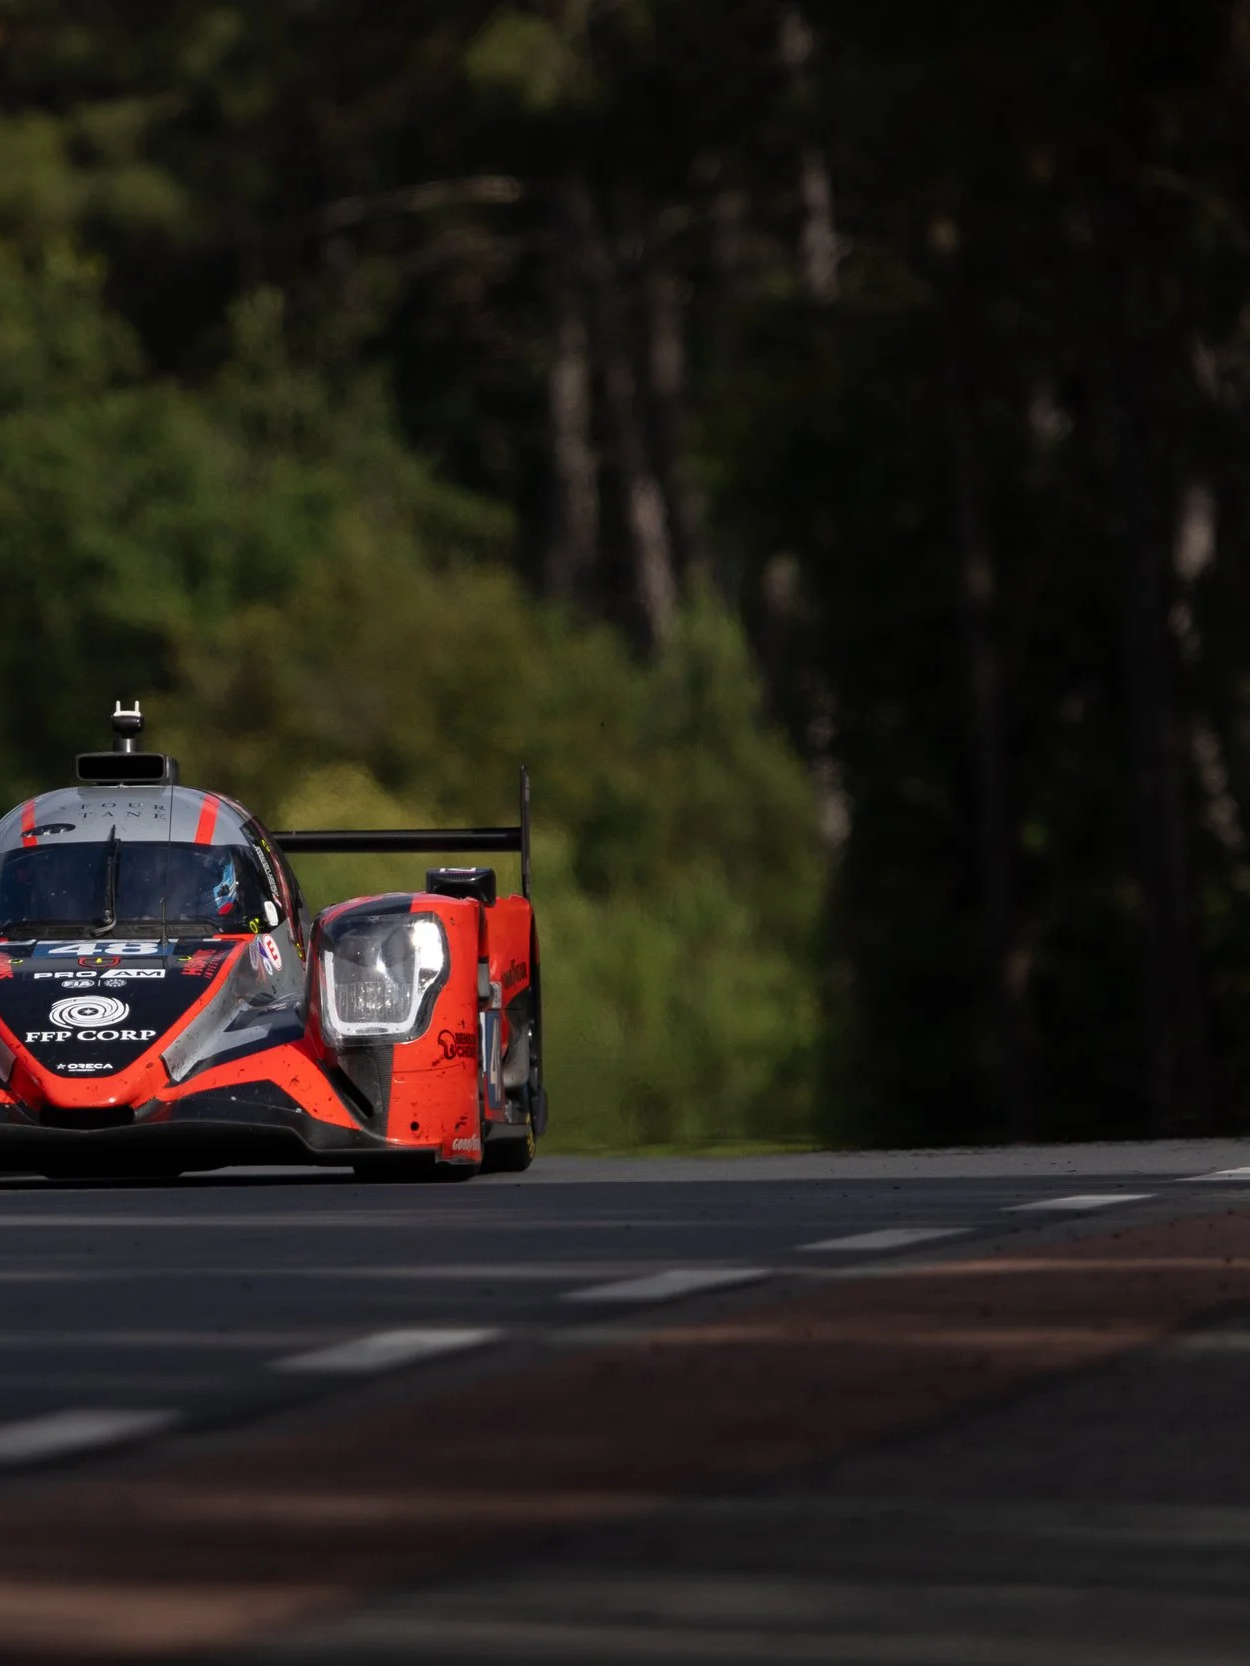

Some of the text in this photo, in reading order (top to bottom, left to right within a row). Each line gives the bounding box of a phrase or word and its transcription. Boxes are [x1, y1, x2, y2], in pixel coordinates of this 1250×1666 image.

[79, 802, 166, 810] FOUR
[78, 811, 166, 820] TANE
[48, 942, 159, 955] 48
[34, 971, 97, 979] PRO
[25, 1030, 156, 1042] FFP CORP
